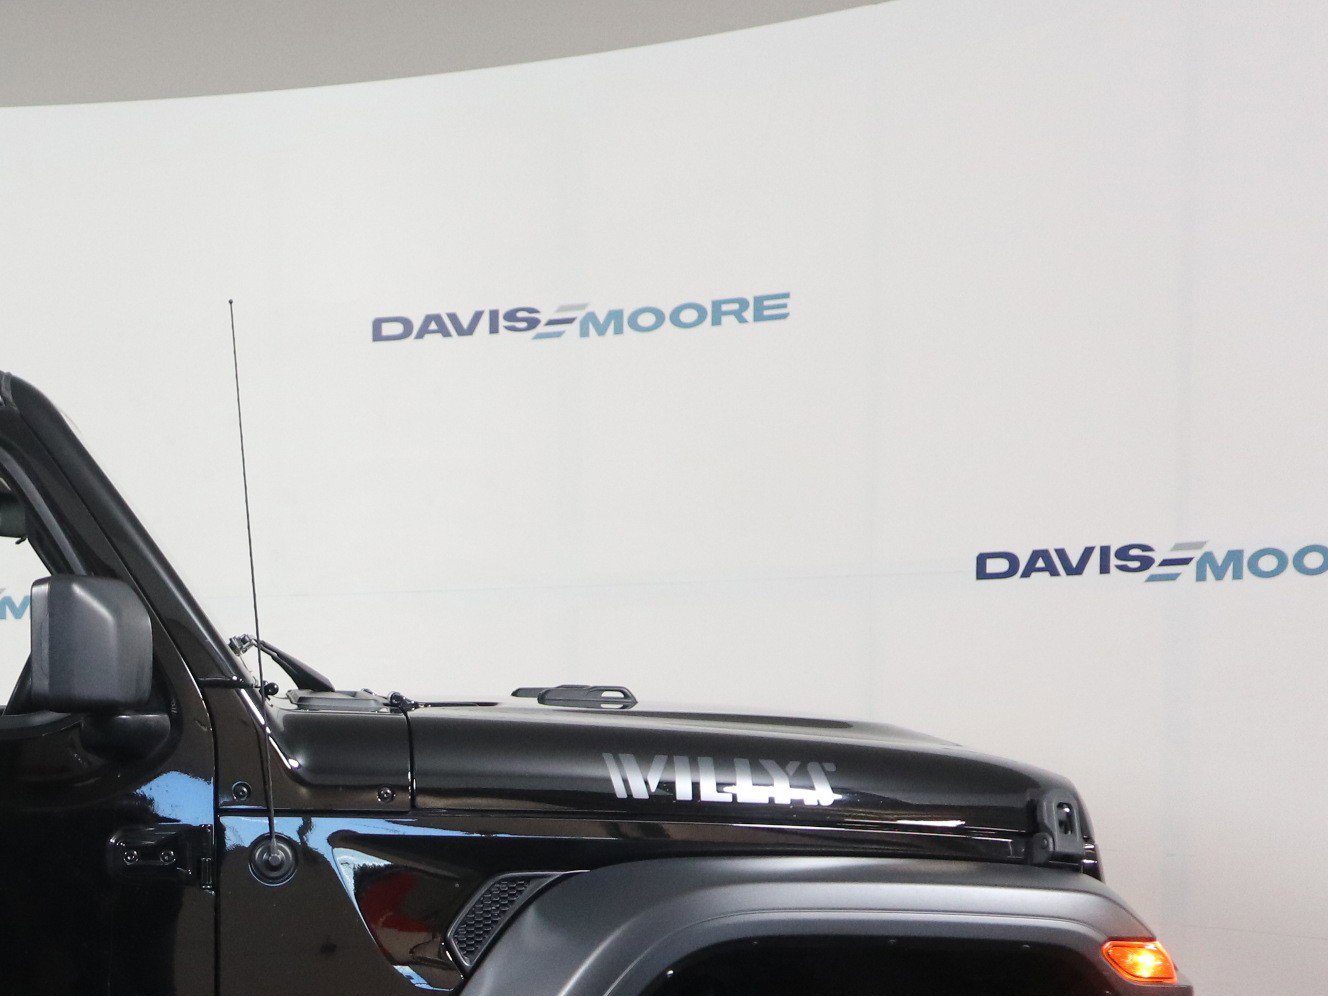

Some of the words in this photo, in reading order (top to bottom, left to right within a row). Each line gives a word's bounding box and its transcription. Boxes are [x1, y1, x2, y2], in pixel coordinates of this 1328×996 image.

[372, 306, 542, 342] DAVIS
[578, 292, 791, 338] MOORE
[976, 543, 1156, 580] DAVIS
[602, 752, 838, 806] WILLYS
